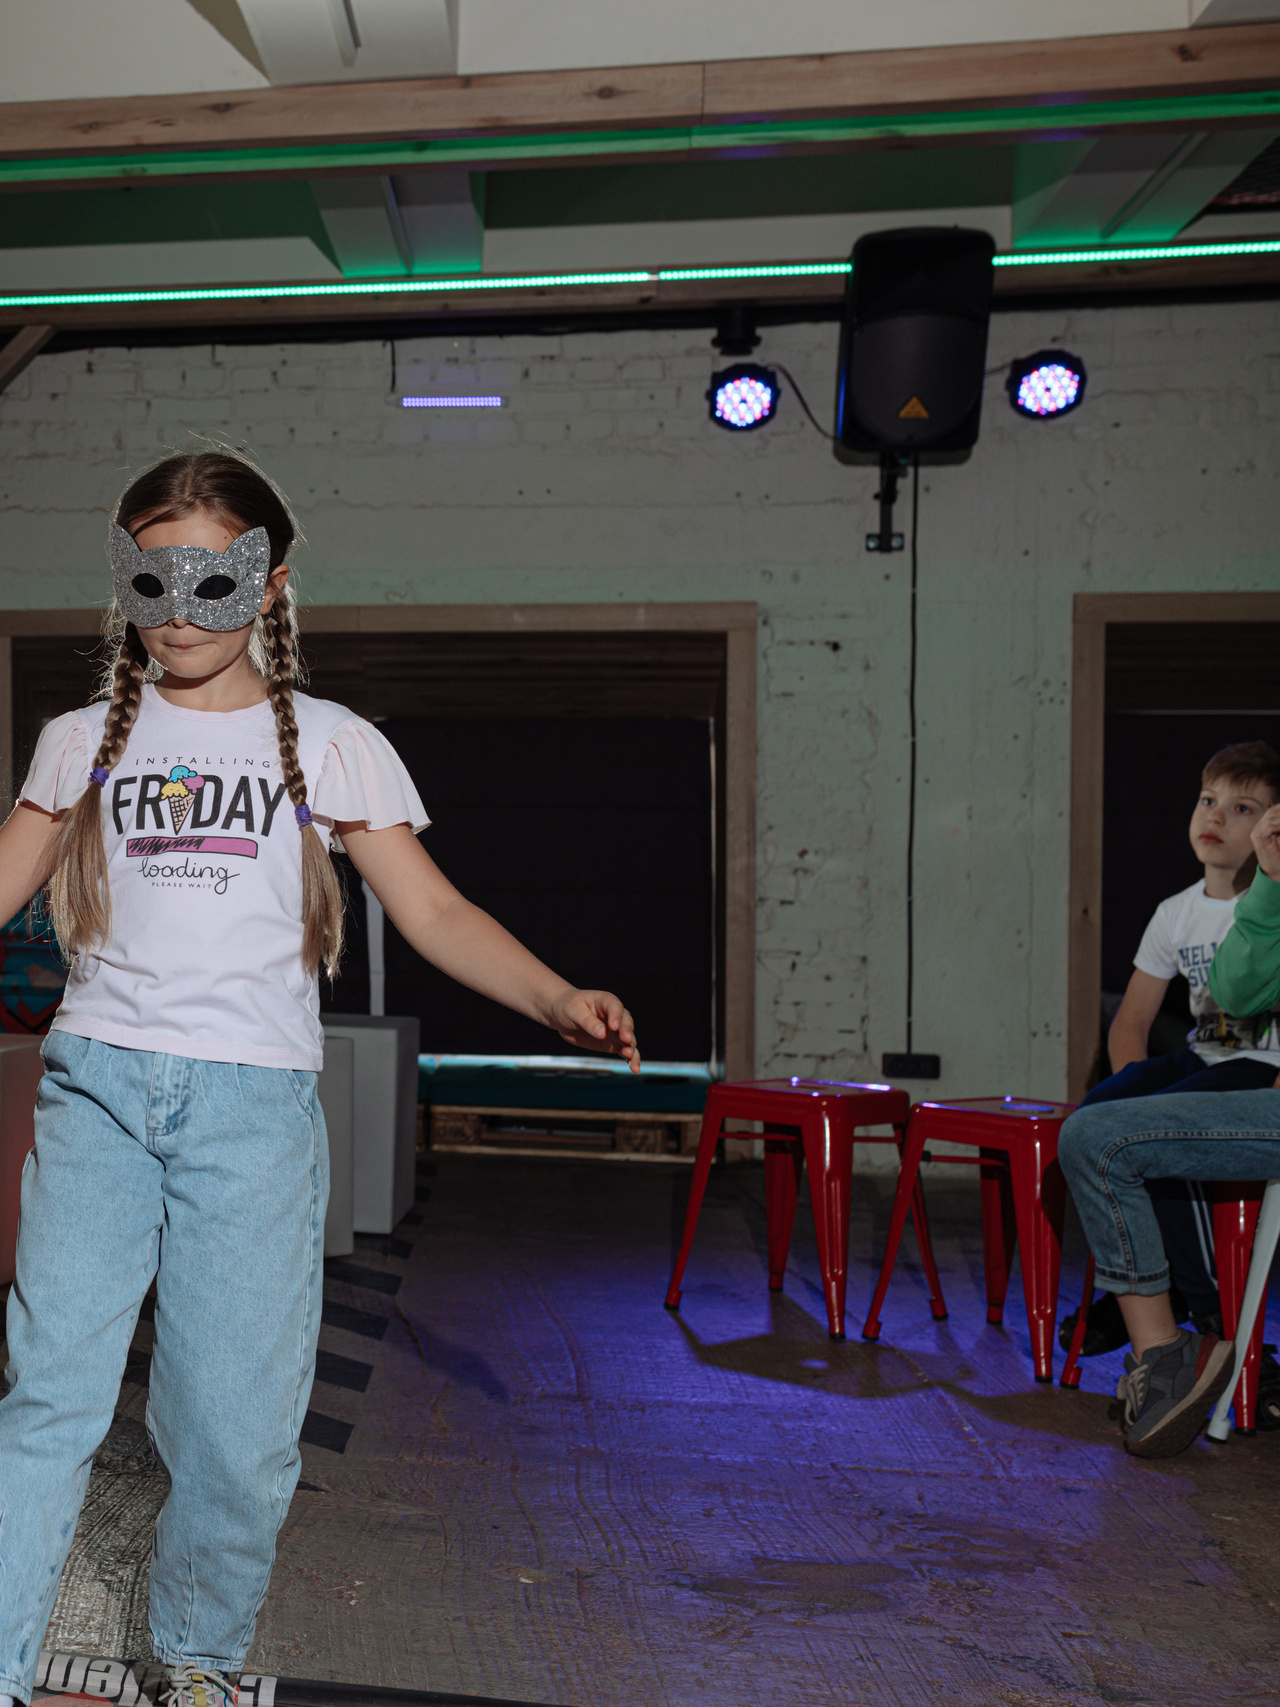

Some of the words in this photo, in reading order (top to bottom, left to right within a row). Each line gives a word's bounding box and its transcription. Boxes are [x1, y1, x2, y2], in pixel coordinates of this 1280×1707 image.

[135, 756, 271, 769] INSTALLING
[137, 857, 240, 895] loading
[151, 881, 183, 889] PLEASE
